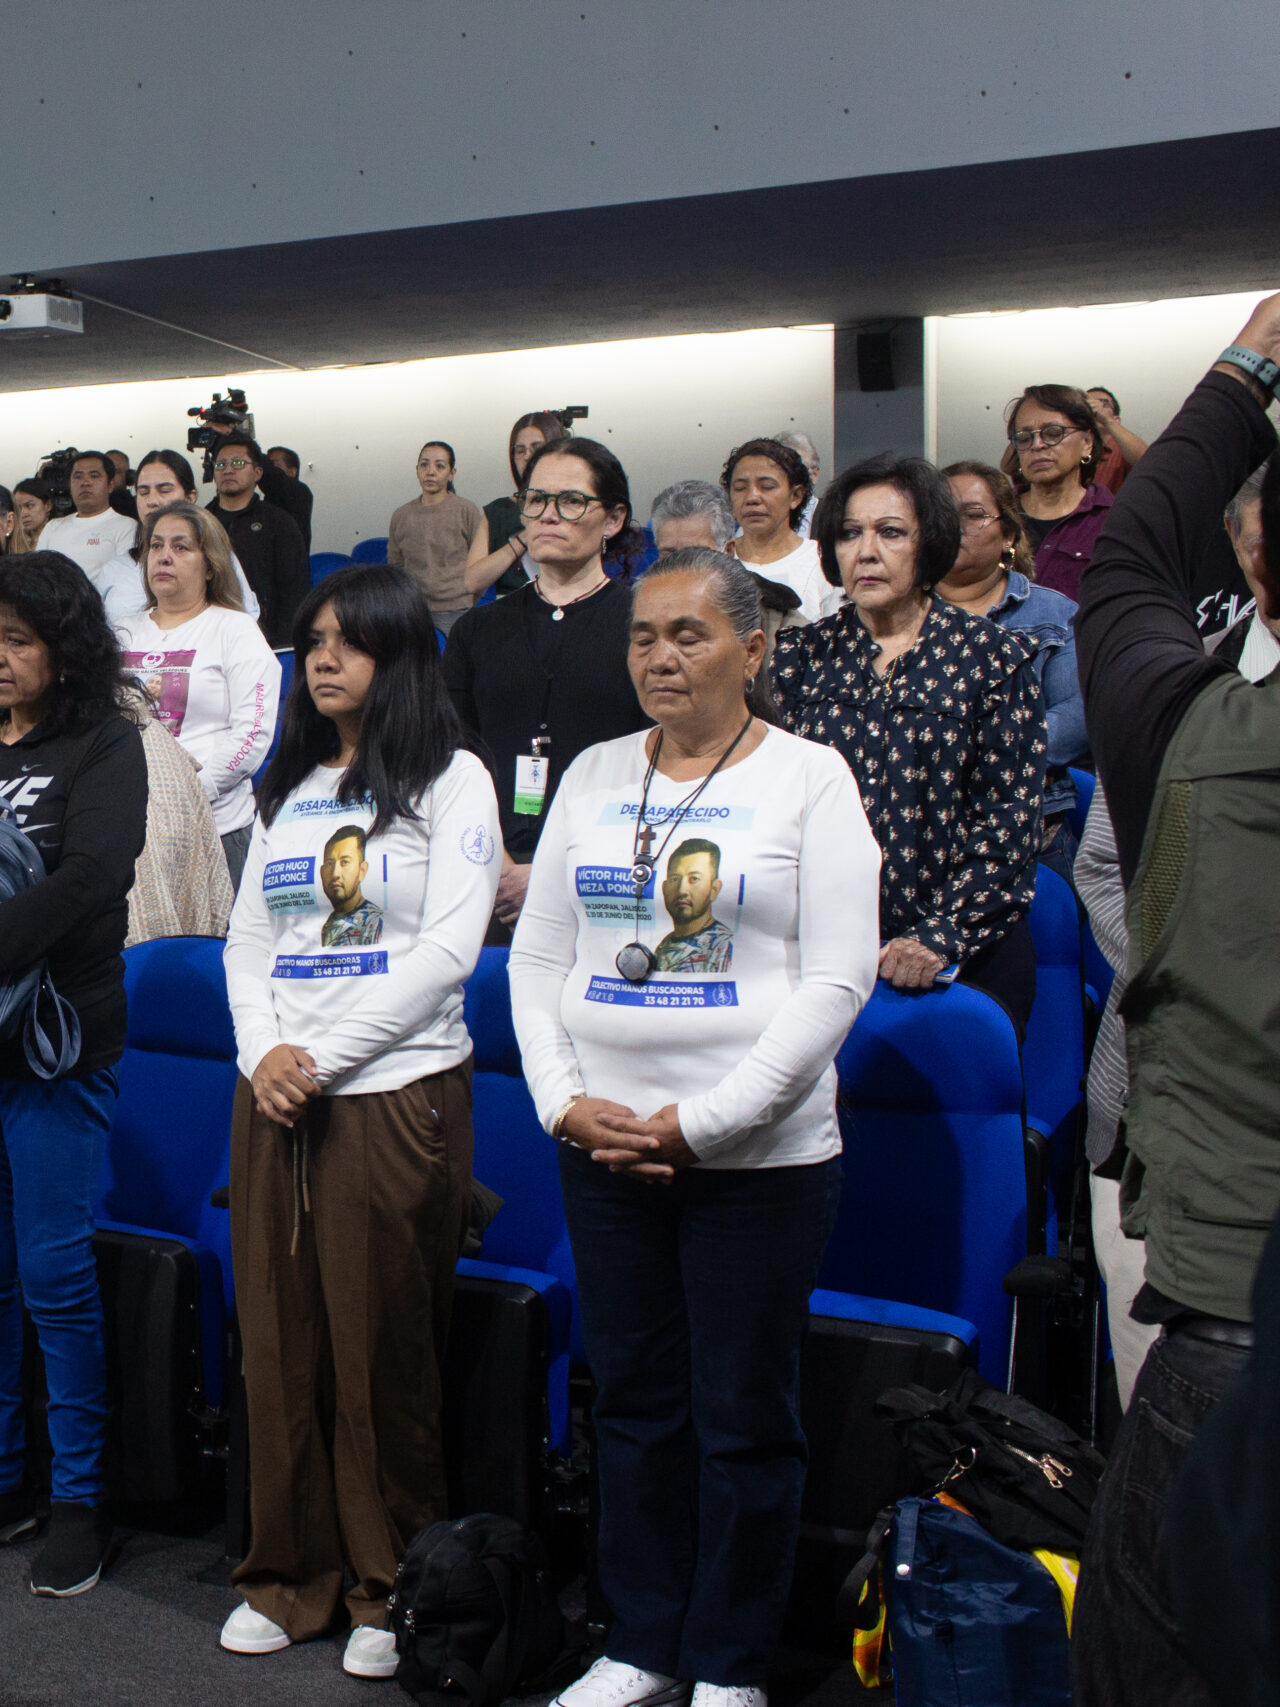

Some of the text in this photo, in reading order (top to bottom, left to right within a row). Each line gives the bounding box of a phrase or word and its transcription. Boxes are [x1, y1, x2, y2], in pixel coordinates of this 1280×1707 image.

[256, 682, 265, 716] MADRE
[620, 804, 730, 818] DEAPARECIDO
[286, 860, 310, 872] HUGO
[280, 872, 308, 884] PONCE
[578, 868, 612, 880] VÍCTOR
[579, 882, 638, 894] MEZA PONC
[315, 956, 361, 966] BUSCADORAS
[314, 966, 362, 976] 33 48 21 21 70
[592, 980, 704, 995] COLECTIVO MANOS BUSCADORAS
[644, 996, 705, 1006] 33 48 21 21 70
